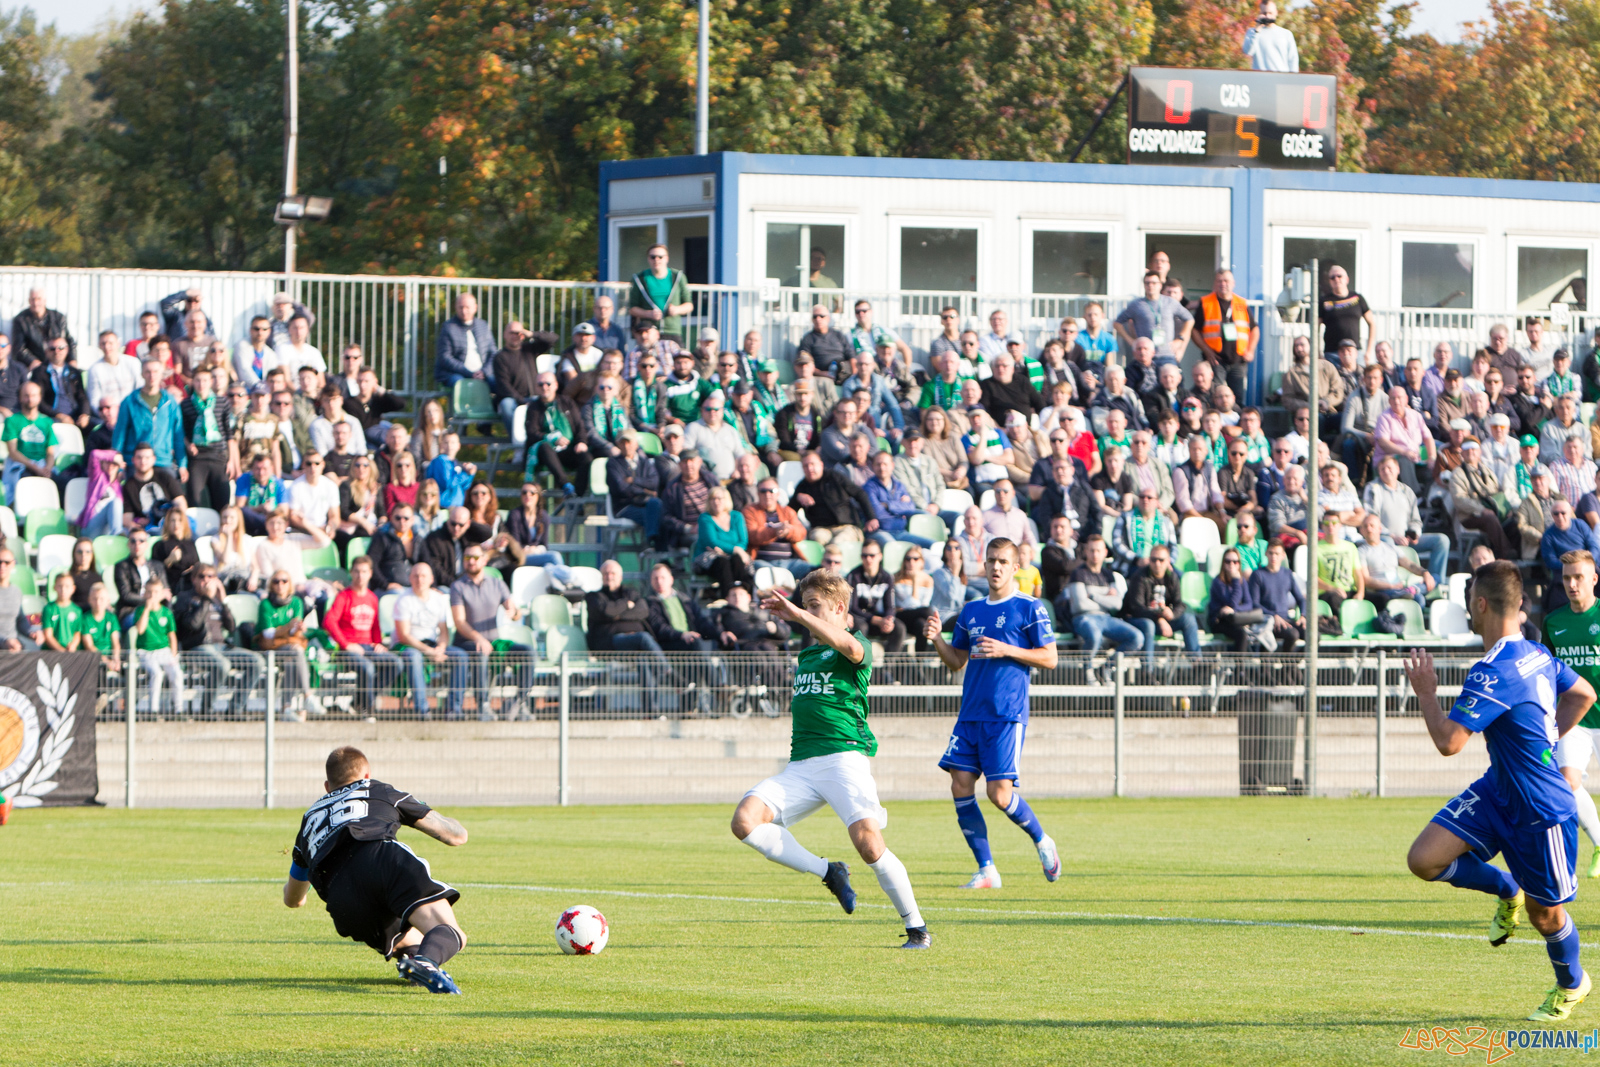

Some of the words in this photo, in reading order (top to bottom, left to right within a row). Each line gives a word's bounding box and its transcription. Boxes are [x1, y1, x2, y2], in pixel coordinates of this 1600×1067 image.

[1165, 80, 1193, 124] 0
[1220, 84, 1251, 108] CZAS
[1303, 85, 1329, 129] 0
[1129, 128, 1207, 155] GOSPODARZE
[1235, 115, 1260, 158] 5
[1281, 129, 1324, 159] GOŚCIE
[1562, 656, 1600, 667] OUSE
[793, 672, 833, 686] AMILY
[793, 683, 836, 697] OUSE
[302, 789, 370, 859] 25
